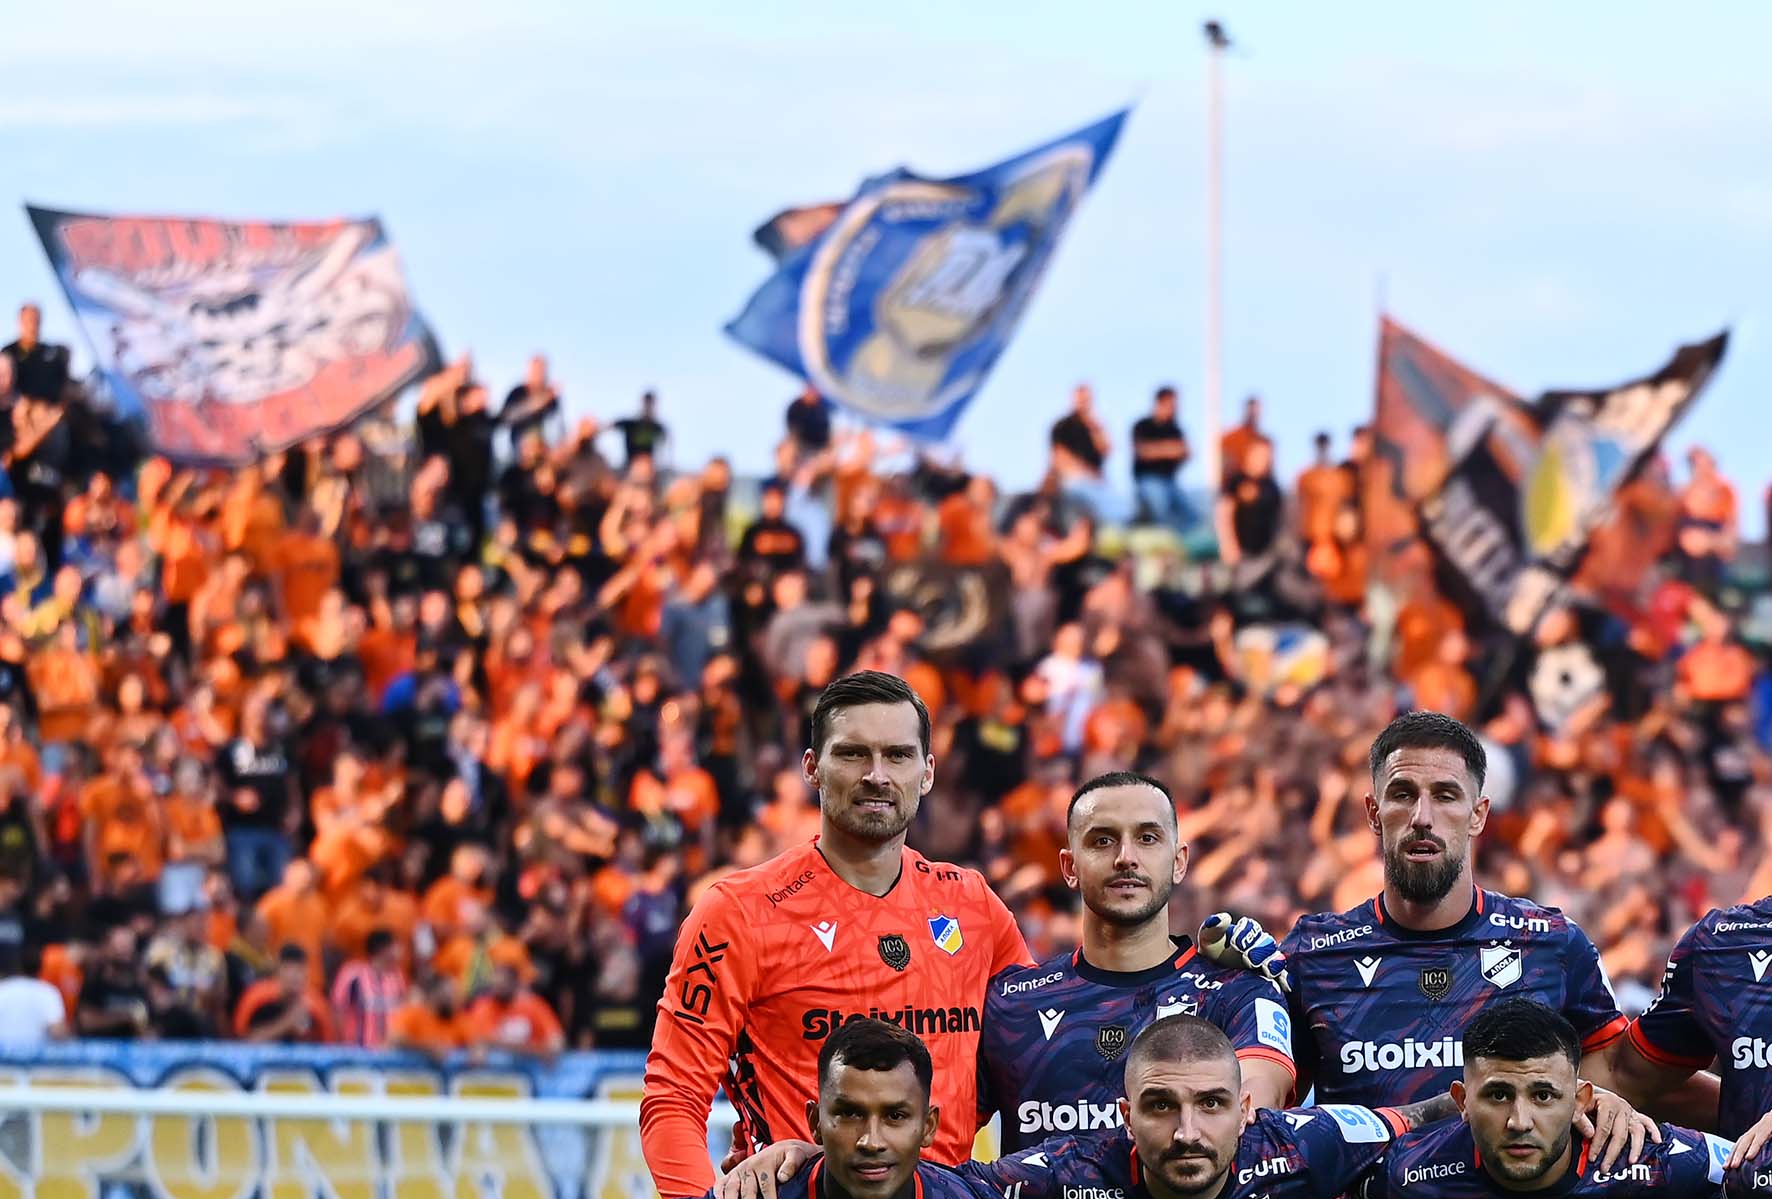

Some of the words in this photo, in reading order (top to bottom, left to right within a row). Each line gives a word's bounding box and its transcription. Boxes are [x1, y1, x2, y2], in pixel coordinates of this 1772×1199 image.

[767, 868, 816, 909] Jointace
[1310, 923, 1374, 951] Jointace
[1001, 970, 1064, 996] Jointace
[1340, 1036, 1464, 1074] Stoixi
[1017, 1098, 1125, 1134] Stoixi
[1401, 1159, 1466, 1187] Jointace
